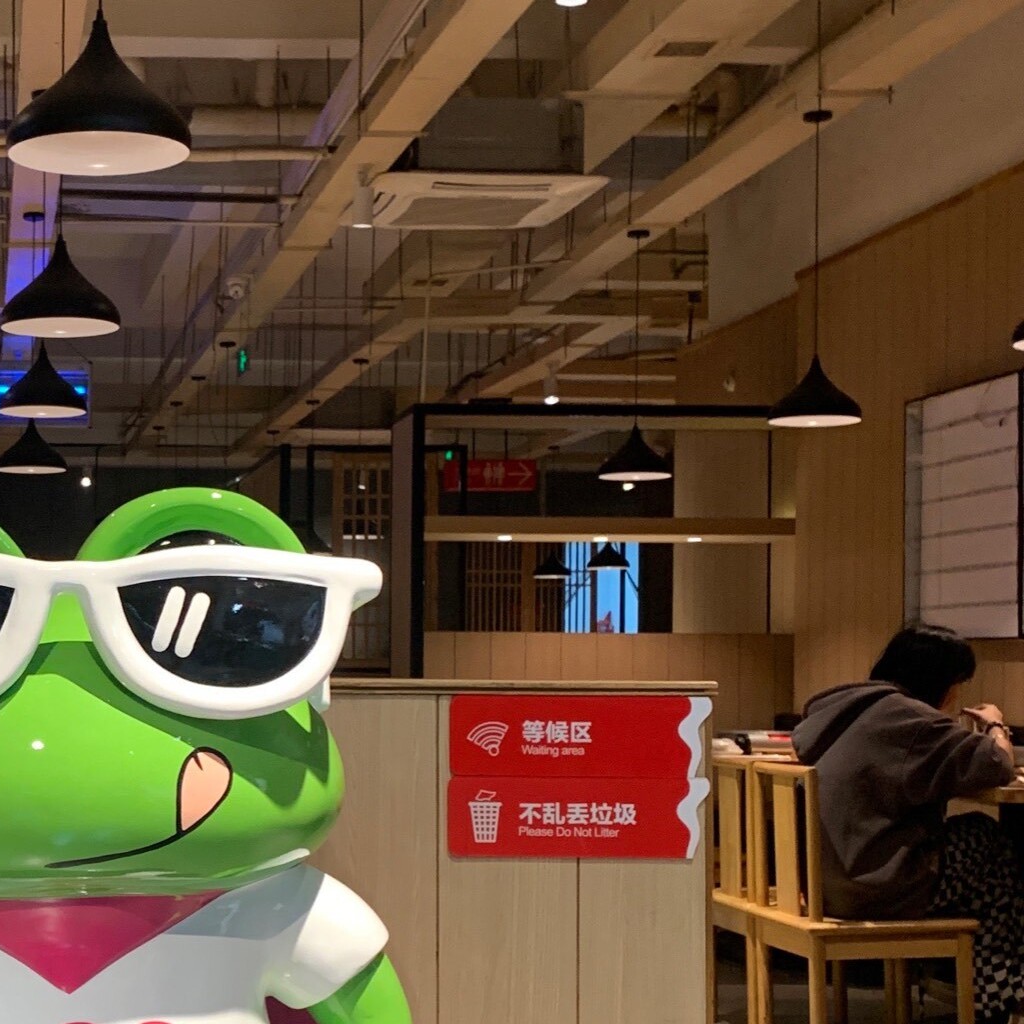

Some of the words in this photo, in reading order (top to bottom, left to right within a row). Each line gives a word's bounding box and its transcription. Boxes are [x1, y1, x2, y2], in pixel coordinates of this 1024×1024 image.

[522, 720, 592, 744] 等候区
[521, 744, 559, 757] Waiting
[561, 746, 585, 756] area
[519, 802, 637, 826] 不乱丢垃圾
[518, 826, 553, 837] Please
[556, 826, 572, 837] Do
[574, 826, 592, 838] Not
[594, 826, 620, 838] Litter
